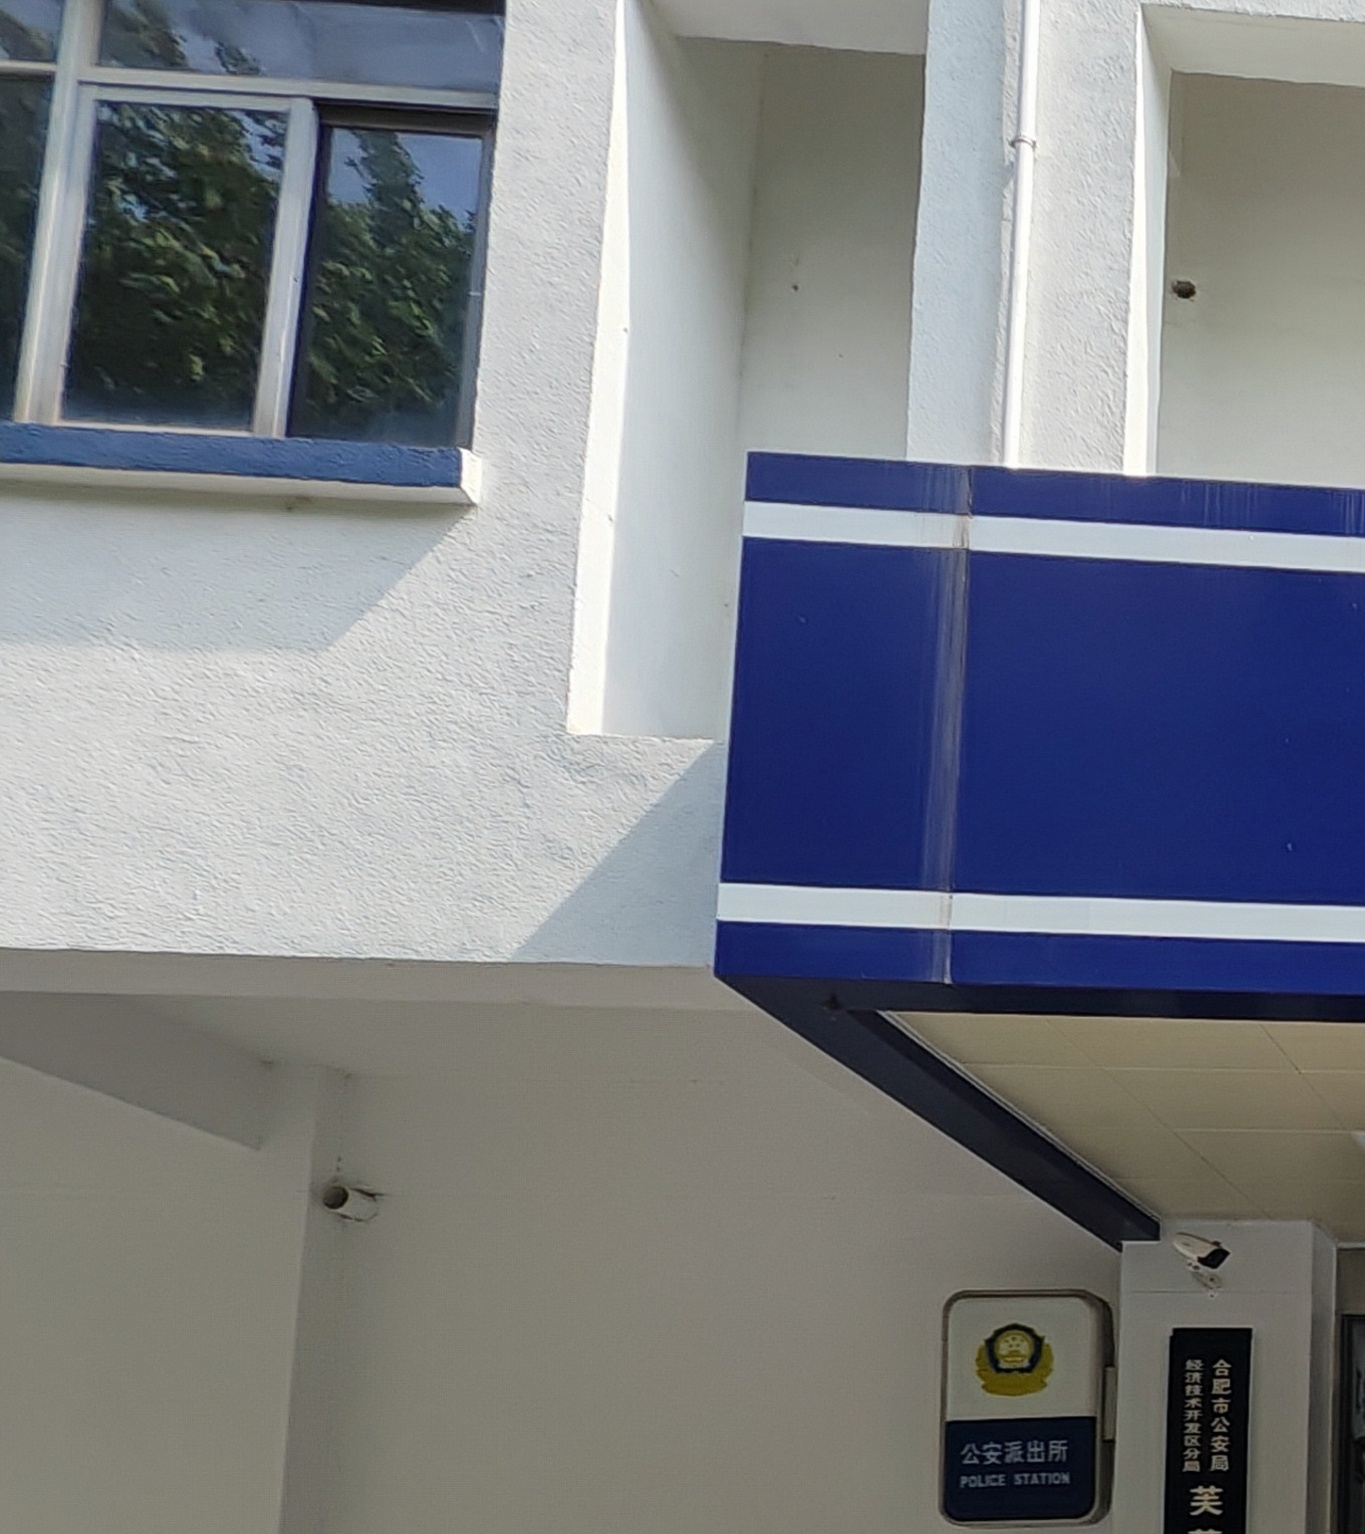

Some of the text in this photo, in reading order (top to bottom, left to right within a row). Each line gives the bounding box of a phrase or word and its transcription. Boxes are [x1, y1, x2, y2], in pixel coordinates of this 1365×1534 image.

[1182, 1360, 1203, 1472] 经济技术开发区分局
[1210, 1359, 1232, 1471] 合肥市公安局
[960, 1440, 1068, 1465] 公安派出所
[960, 1472, 1070, 1488] POLICE STATION
